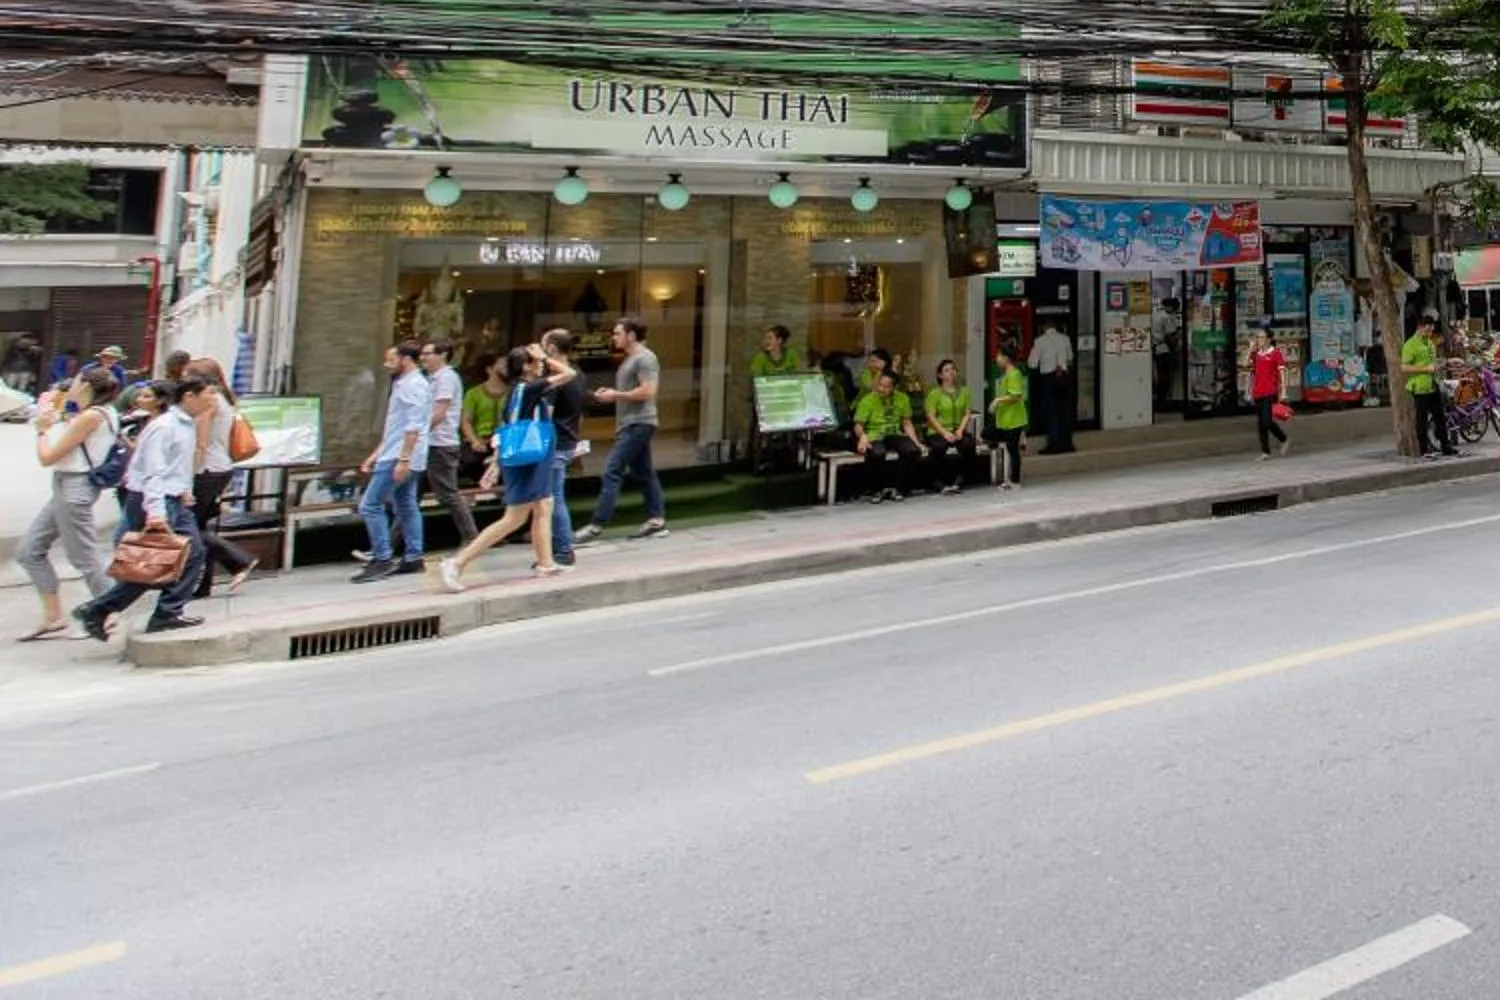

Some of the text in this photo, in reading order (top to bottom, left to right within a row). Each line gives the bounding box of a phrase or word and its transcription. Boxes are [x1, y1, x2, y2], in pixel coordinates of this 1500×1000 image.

[569, 80, 735, 118] URBAN
[752, 91, 850, 123] THAI
[644, 124, 796, 150] MASSAGE
